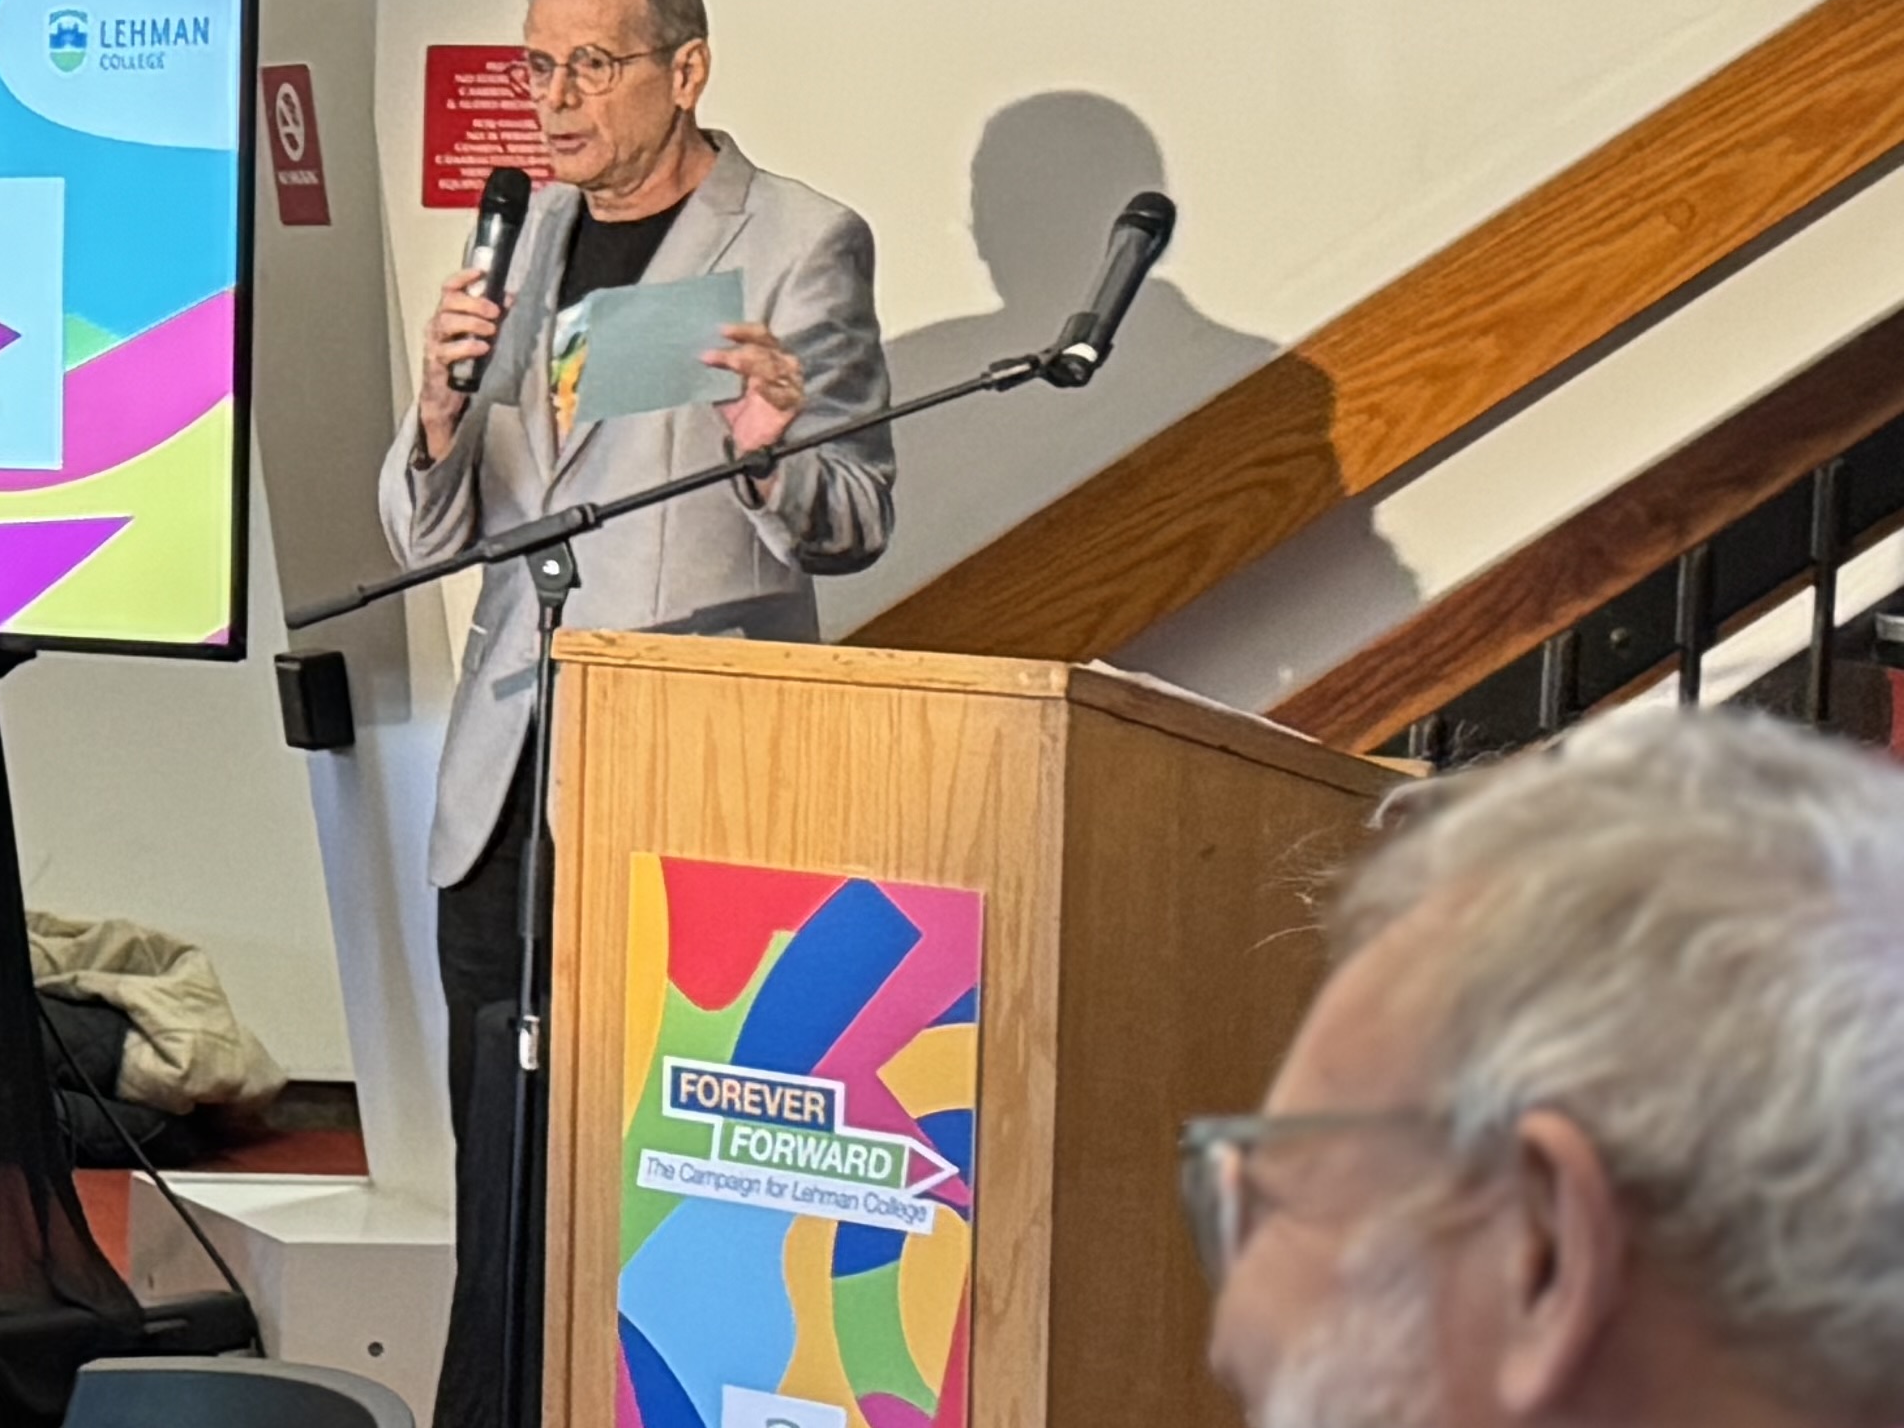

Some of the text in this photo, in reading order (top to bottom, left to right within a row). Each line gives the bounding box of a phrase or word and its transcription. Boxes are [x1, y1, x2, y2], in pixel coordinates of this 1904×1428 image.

[99, 16, 210, 49] LEHMAN
[99, 51, 165, 71] COLLEGE
[678, 1071, 827, 1125] FOREVER
[729, 1124, 893, 1180] FORWARD
[646, 1156, 928, 1225] The Campaign for Lehman College
